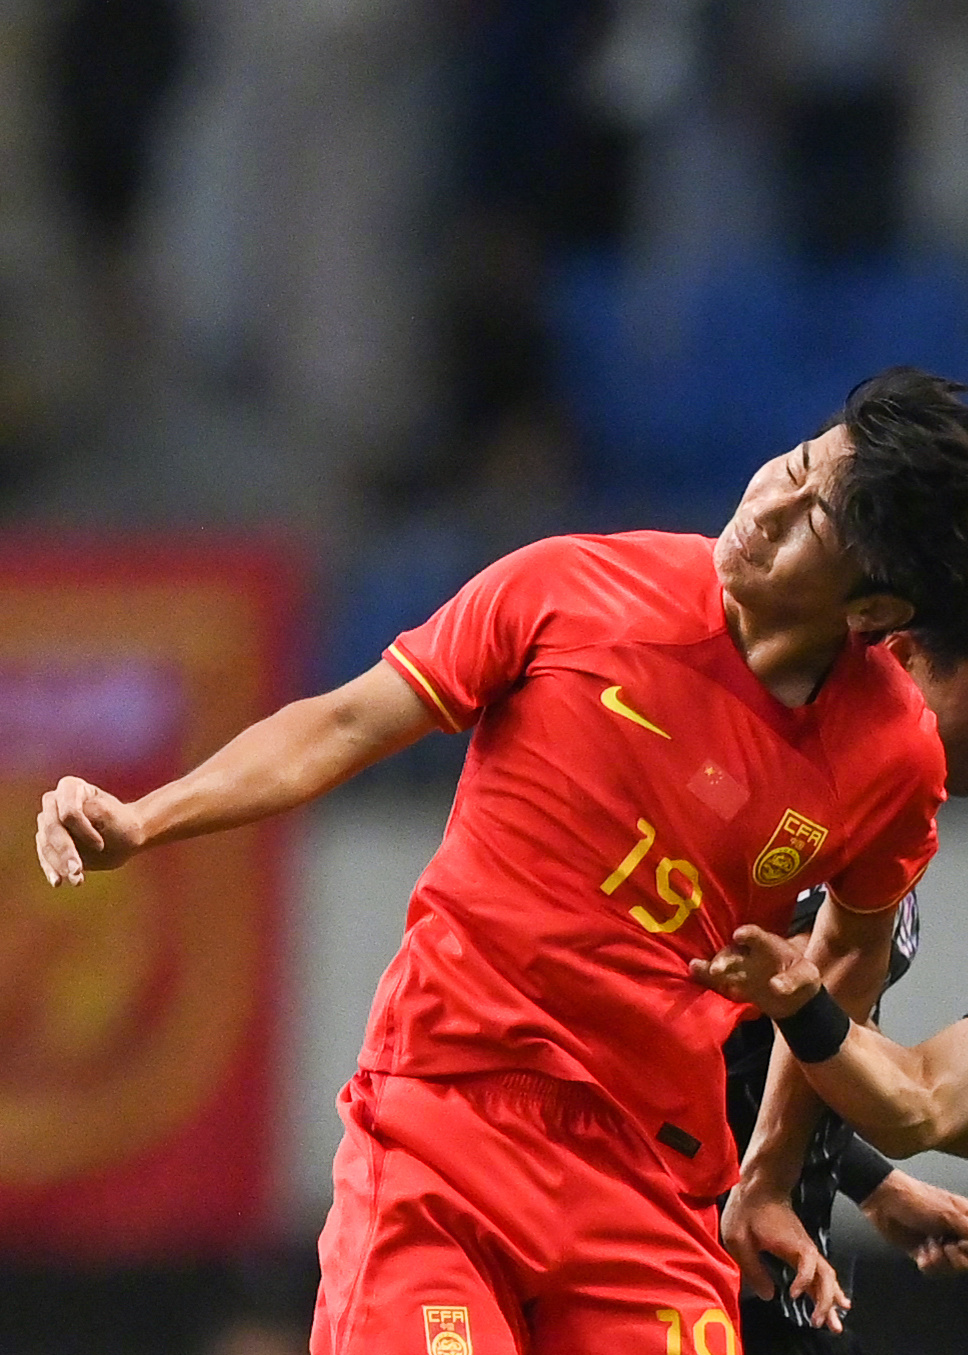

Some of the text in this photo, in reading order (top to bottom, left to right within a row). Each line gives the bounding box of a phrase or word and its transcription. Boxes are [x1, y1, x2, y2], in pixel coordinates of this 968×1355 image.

[783, 816, 822, 847] CFA
[600, 817, 703, 933] 19
[428, 1310, 465, 1323] CFA
